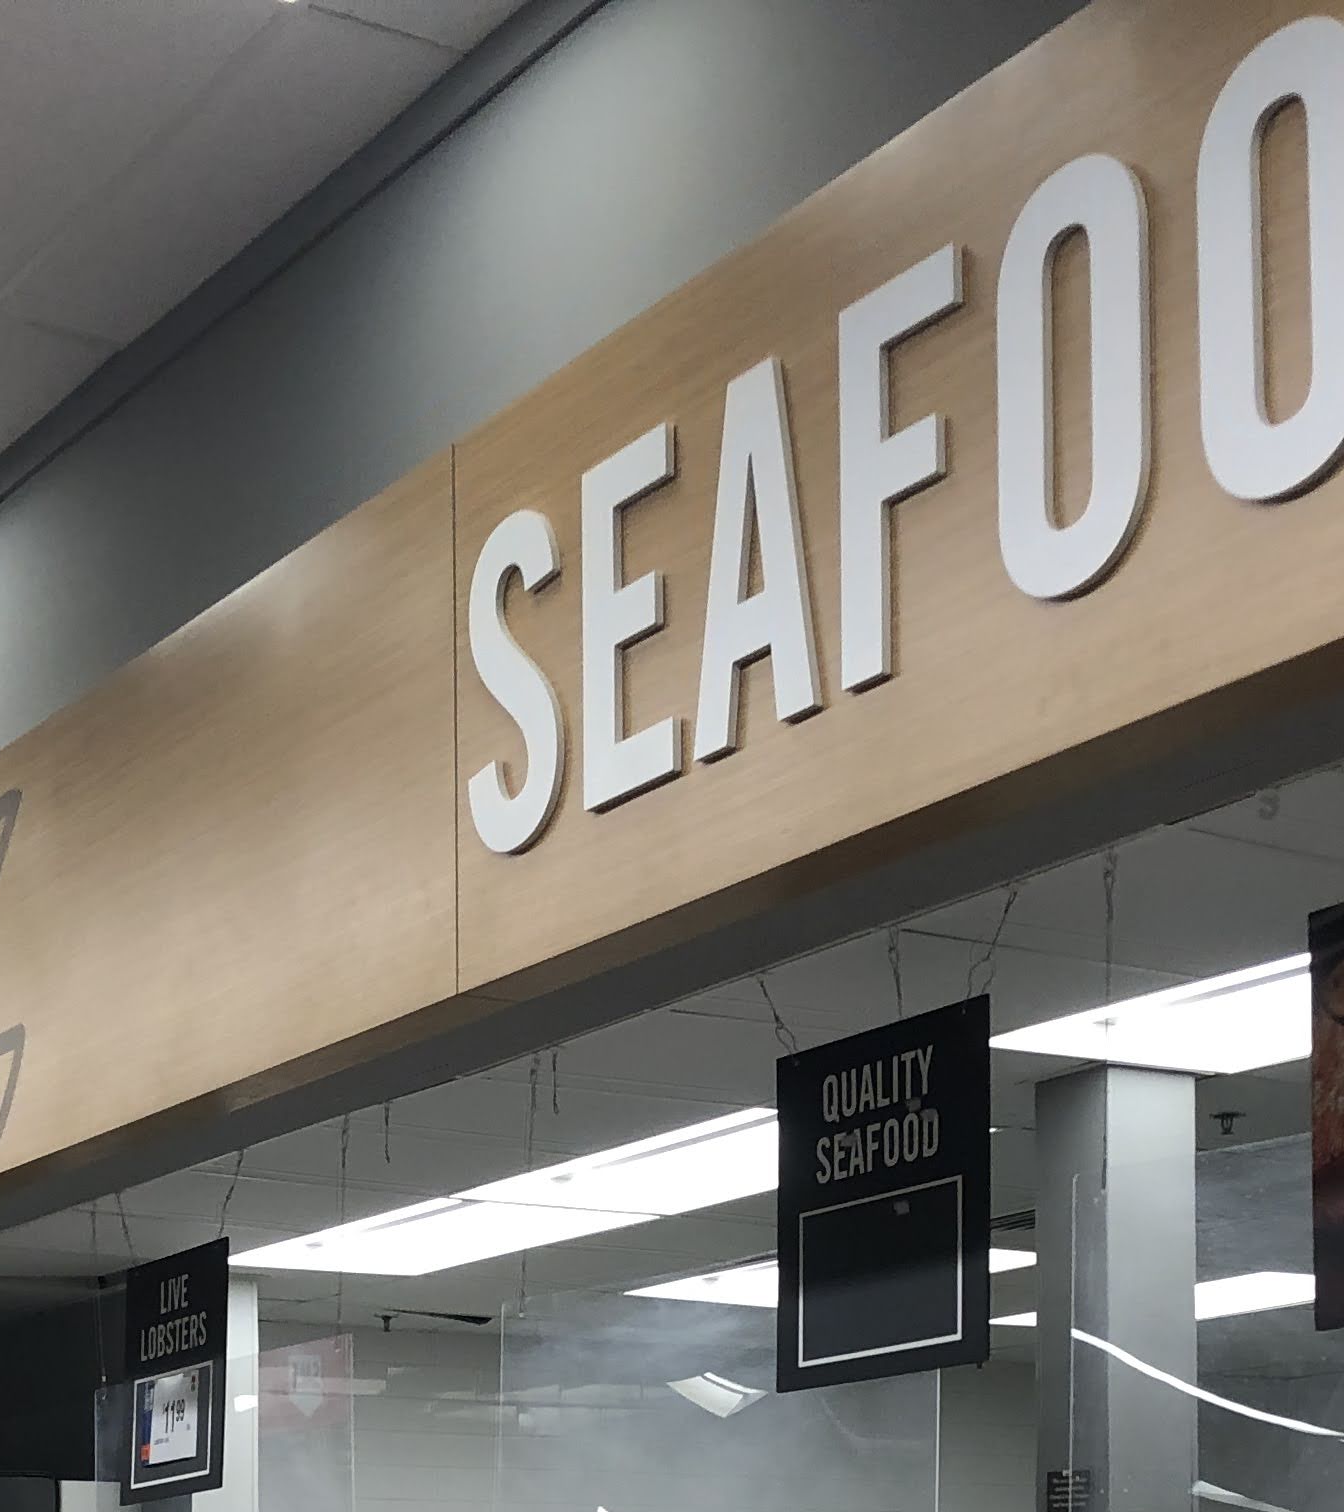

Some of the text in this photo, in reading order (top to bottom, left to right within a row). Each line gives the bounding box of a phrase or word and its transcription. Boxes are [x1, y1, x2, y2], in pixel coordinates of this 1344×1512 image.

[821, 1044, 934, 1124] QUALITY
[815, 1108, 940, 1185] SEAFOOD
[159, 1272, 190, 1315] LIVE
[139, 1310, 208, 1362] LOBSTERS
